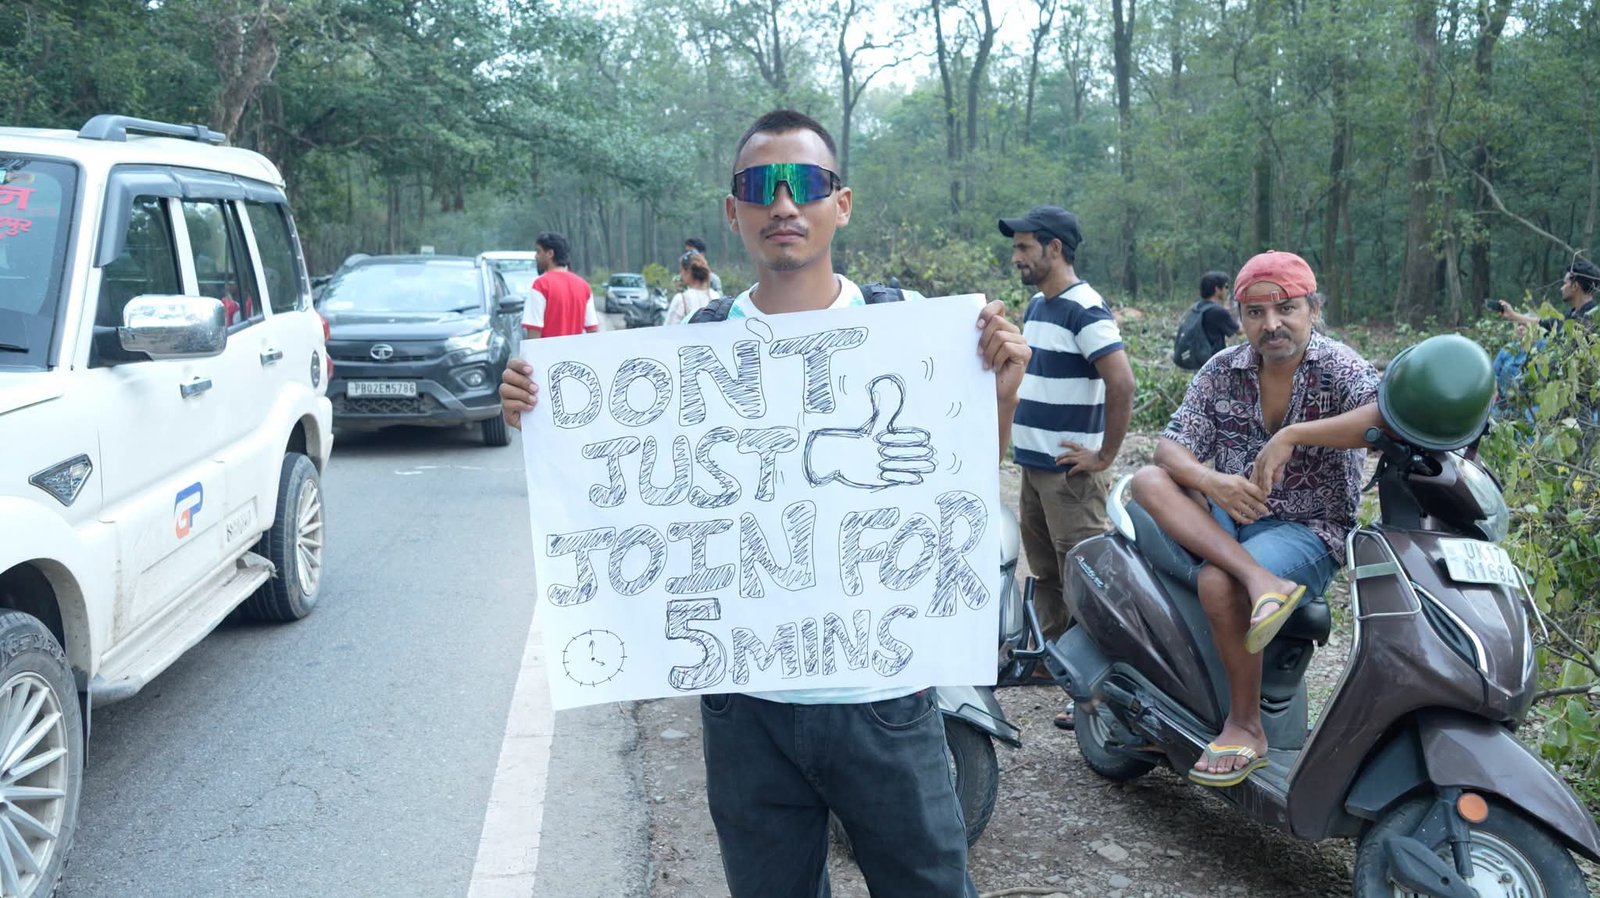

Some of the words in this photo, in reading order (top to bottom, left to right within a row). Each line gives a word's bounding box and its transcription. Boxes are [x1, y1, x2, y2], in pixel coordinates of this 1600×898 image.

[548, 317, 869, 429] DON'T
[582, 426, 800, 508] JUST
[546, 500, 816, 606] JOIN
[838, 490, 991, 617] FOR
